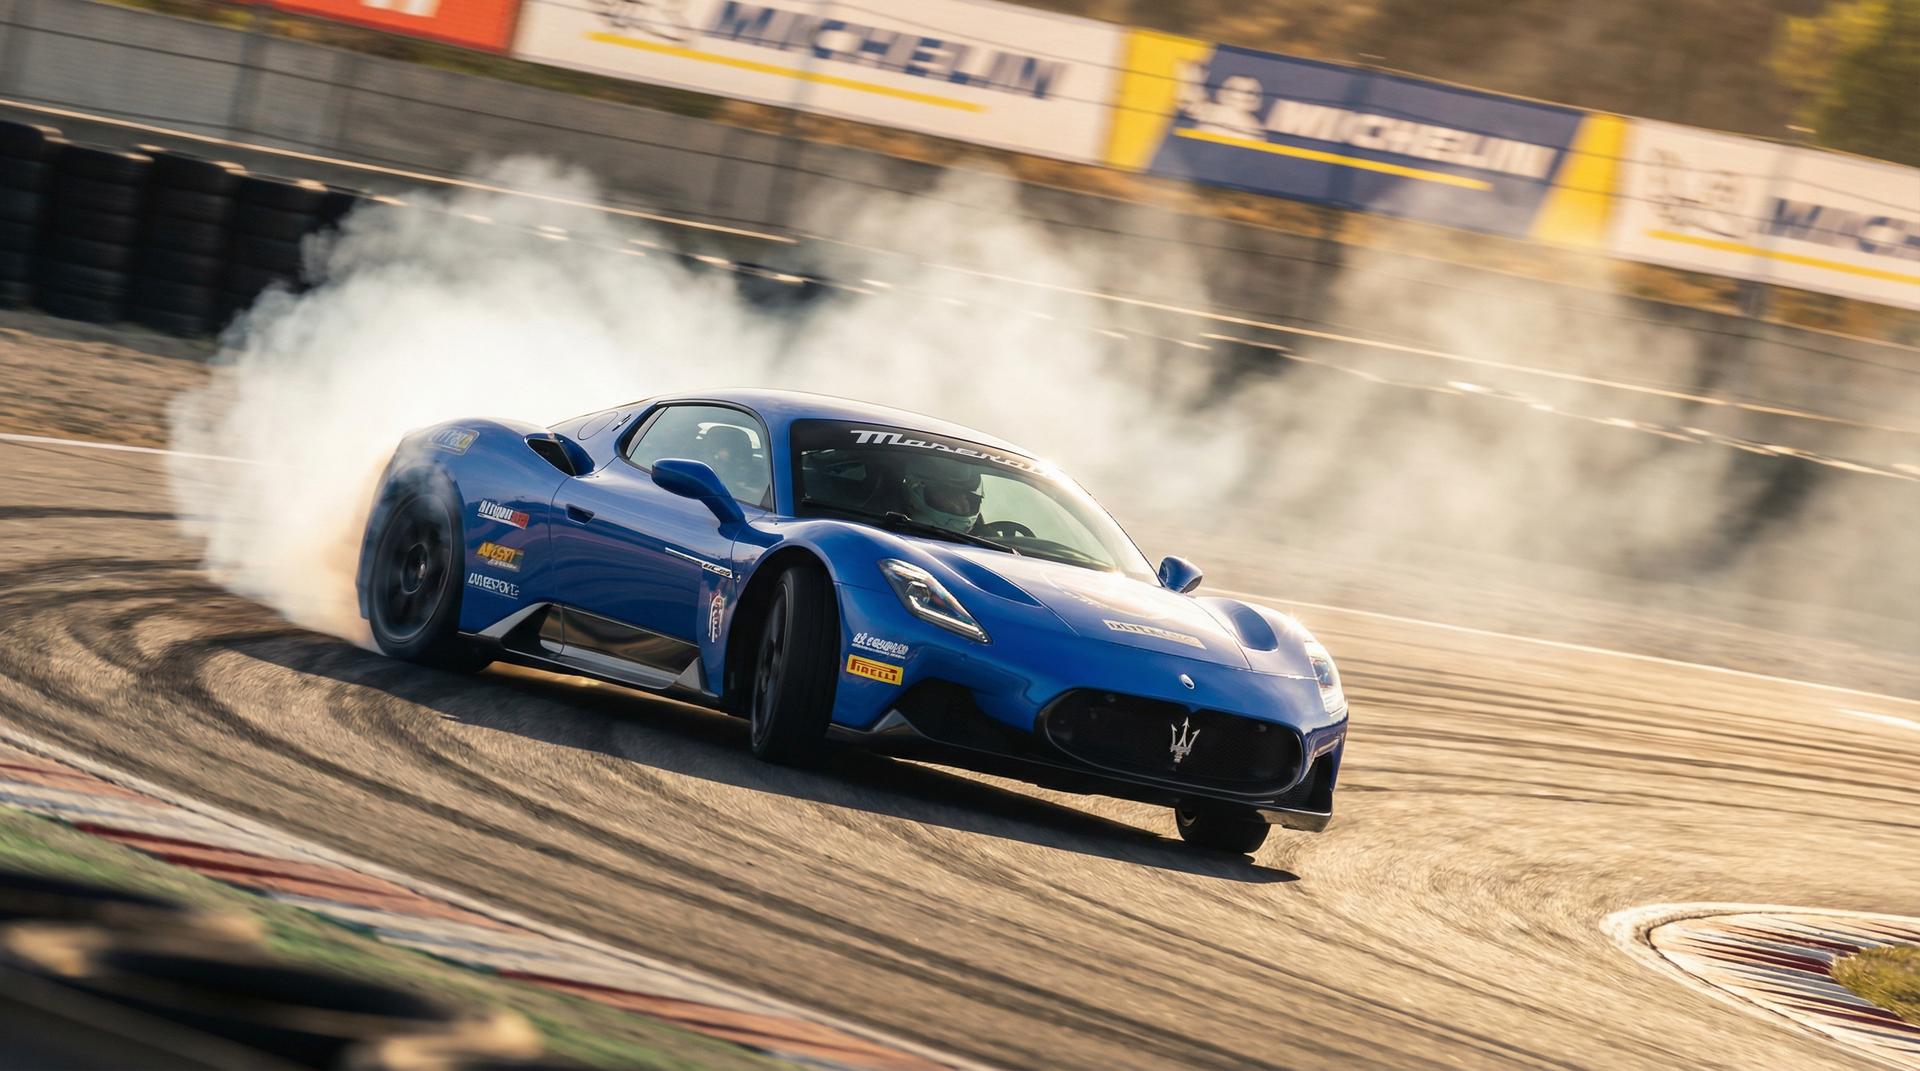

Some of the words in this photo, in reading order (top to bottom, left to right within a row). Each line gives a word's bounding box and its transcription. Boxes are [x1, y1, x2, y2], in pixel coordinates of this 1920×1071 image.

[702, 0, 1070, 98] MICHELIN
[1263, 98, 1559, 180] MICHELIN
[851, 430, 1041, 475] Masera
[850, 658, 898, 682] PIRELLI
